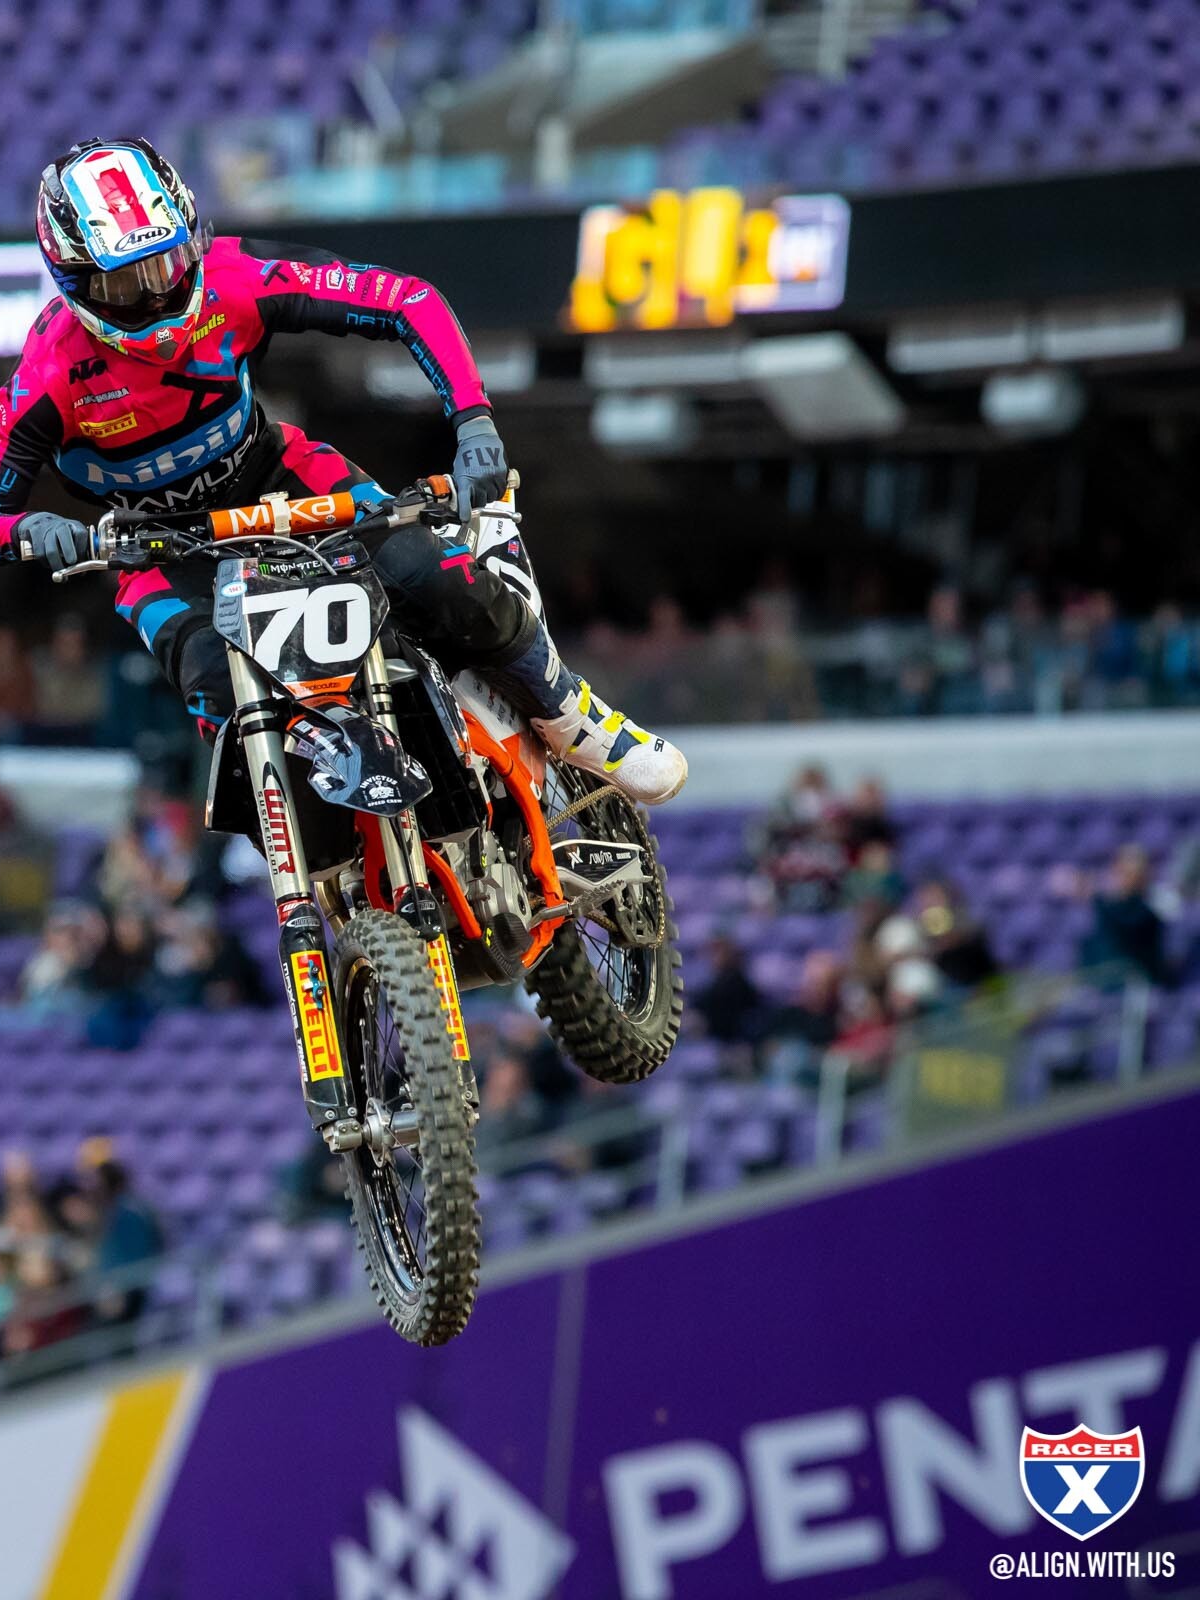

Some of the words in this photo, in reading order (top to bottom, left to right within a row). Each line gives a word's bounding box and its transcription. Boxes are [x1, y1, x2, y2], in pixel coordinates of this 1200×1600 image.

[127, 226, 164, 245] Arai
[462, 447, 501, 467] FLY
[242, 582, 370, 671] 70
[360, 775, 398, 789] INVICTUS
[297, 953, 338, 1074] PIRELLI
